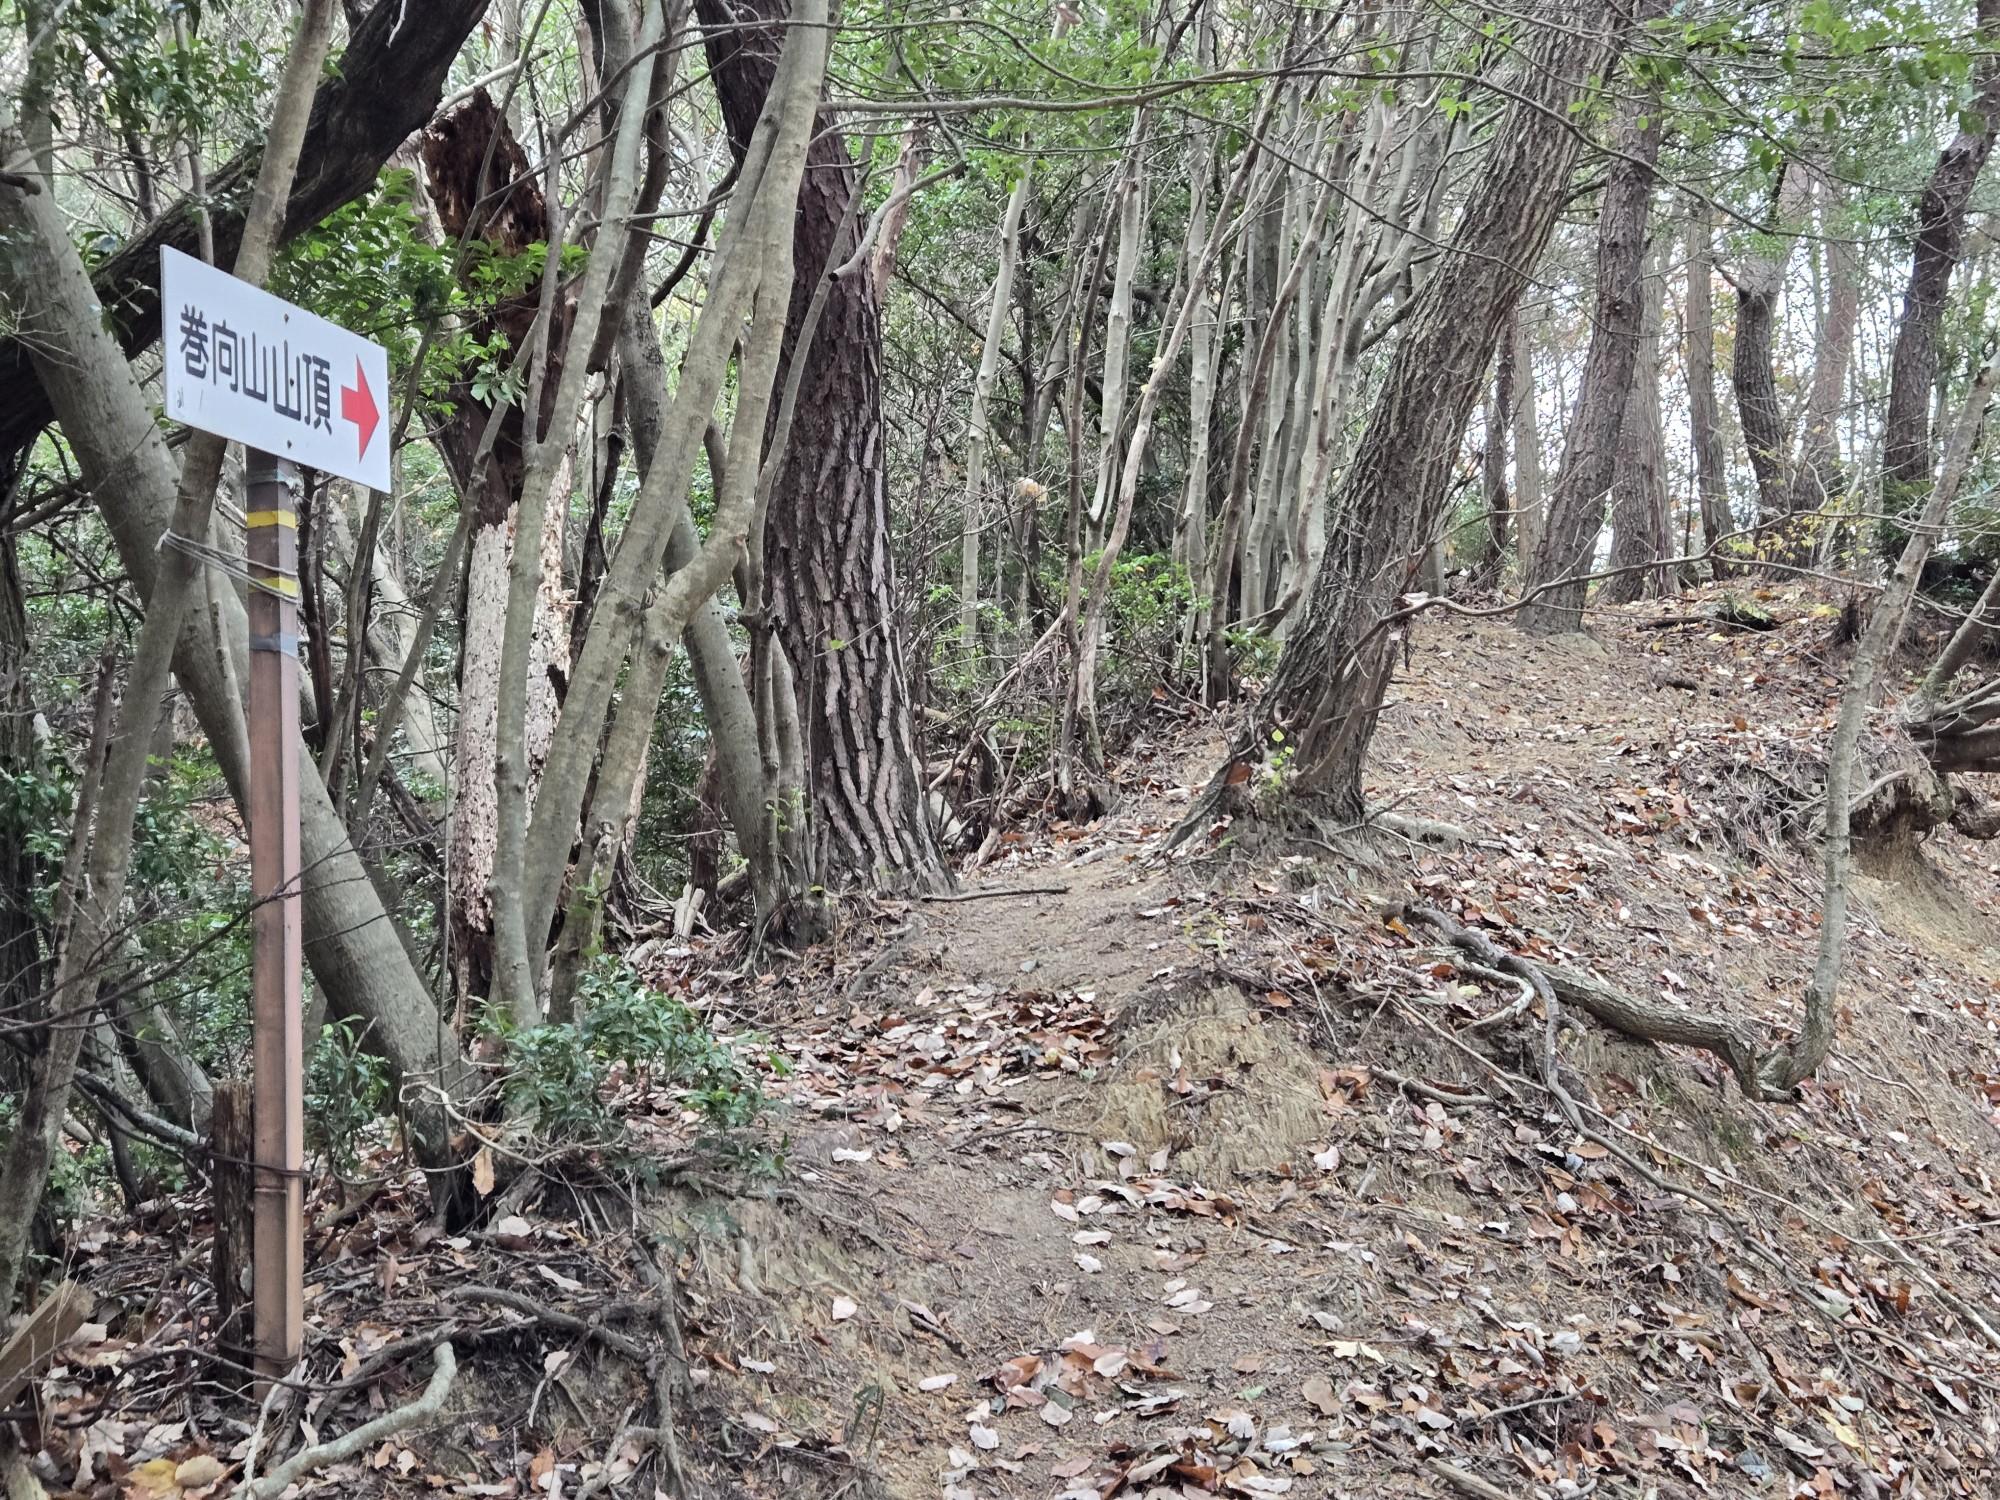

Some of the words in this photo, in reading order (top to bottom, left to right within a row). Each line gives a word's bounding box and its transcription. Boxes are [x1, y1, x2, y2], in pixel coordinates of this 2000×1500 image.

[180, 303, 332, 435] 巻向山山頂
